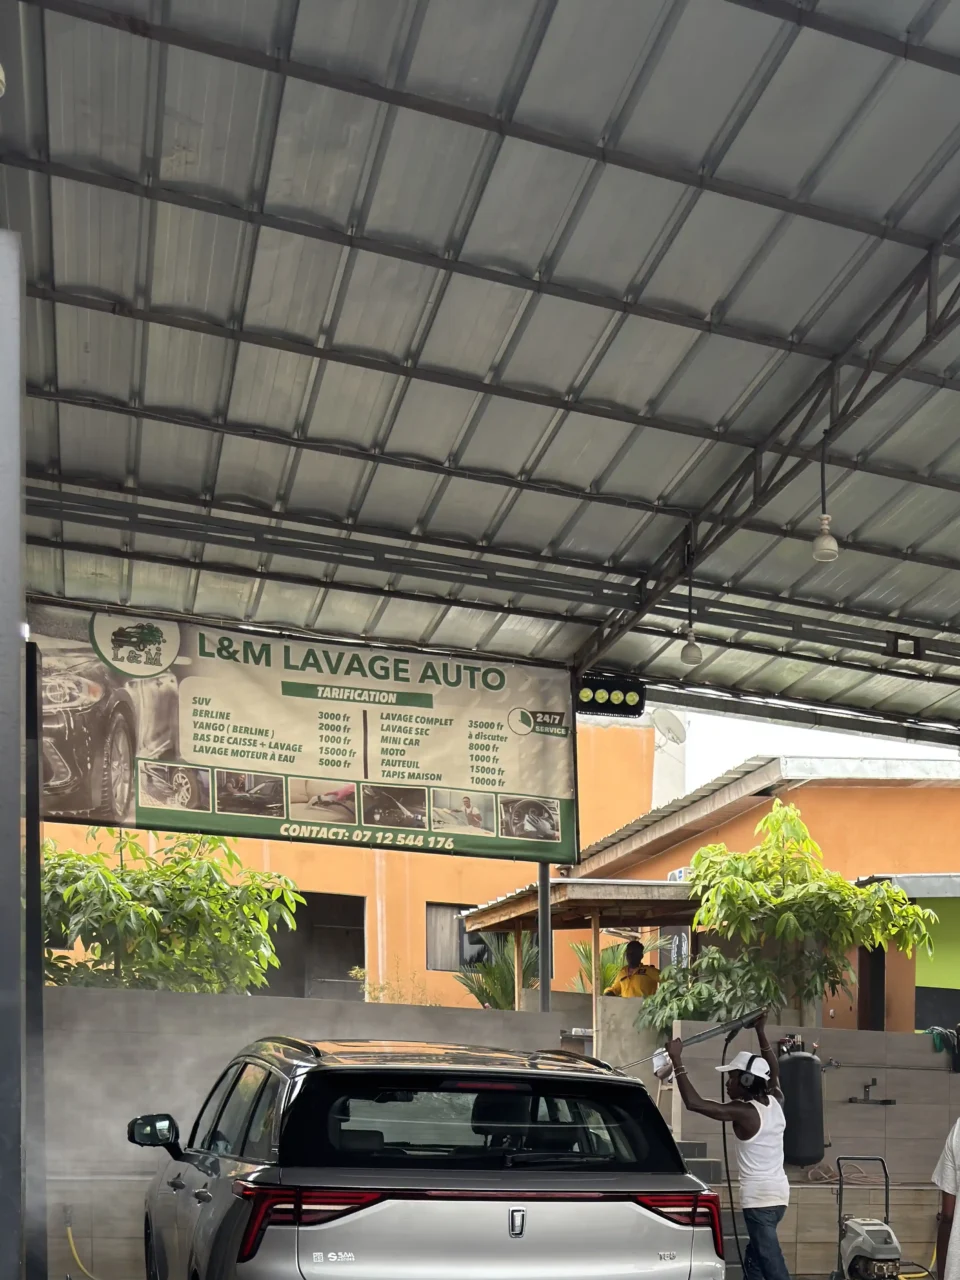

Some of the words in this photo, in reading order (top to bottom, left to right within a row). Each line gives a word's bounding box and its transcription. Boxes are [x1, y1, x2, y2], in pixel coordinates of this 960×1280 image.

[112, 646, 124, 662] L
[126, 650, 142, 664] &
[144, 650, 162, 666] M
[198, 632, 271, 667] L&M
[283, 646, 410, 682] LAVAGE
[418, 661, 506, 690] AUTO
[192, 696, 211, 706] SUV
[316, 686, 398, 704] TARIFICATION
[192, 708, 231, 720] BERLINE
[318, 711, 341, 721] 3000
[342, 713, 351, 722] fr
[380, 712, 414, 723] LAVAGE
[414, 715, 454, 727] COMPLET
[536, 712, 561, 724] 24/7
[192, 720, 226, 732] YANGO
[232, 725, 270, 738] BERLINE
[318, 722, 342, 733] 2000
[342, 724, 351, 734] fr
[380, 723, 413, 735] LAVAGE
[413, 726, 430, 736] SEC
[467, 719, 495, 730] 35000
[496, 721, 504, 731] fr
[535, 725, 567, 735] SERVICE
[192, 732, 211, 743] BAS
[212, 735, 225, 744] DE
[226, 736, 258, 748] CAISSE
[268, 741, 304, 753] LAVAGE
[318, 734, 342, 745] 1000
[343, 736, 352, 745] fr
[380, 735, 401, 746] MINI
[402, 737, 420, 747] CAR
[467, 731, 473, 740] à
[474, 732, 508, 743] discuter
[318, 746, 348, 757] 15000
[348, 748, 357, 758] fr
[380, 746, 406, 757] MOTO
[468, 742, 491, 753] 8000
[491, 744, 500, 753] fr
[193, 744, 229, 757] LAVAGE
[230, 749, 268, 761] MOTEUR
[269, 751, 277, 761] À
[277, 753, 296, 764] EAU
[469, 753, 491, 764] 1000
[491, 755, 500, 765] fr
[318, 758, 342, 768] 5000
[343, 759, 352, 769] fr
[380, 758, 420, 770] FAUTEUIL
[381, 769, 407, 780] TAPIS
[407, 772, 443, 782] MAISON
[469, 765, 496, 776] 15000
[497, 767, 505, 777] fr
[469, 776, 497, 787] 10000
[497, 778, 506, 788] fr
[279, 823, 350, 841] CONTACT:
[352, 829, 372, 842] 07
[375, 831, 394, 845] 12
[395, 833, 424, 847] 544
[427, 835, 455, 850] 176
